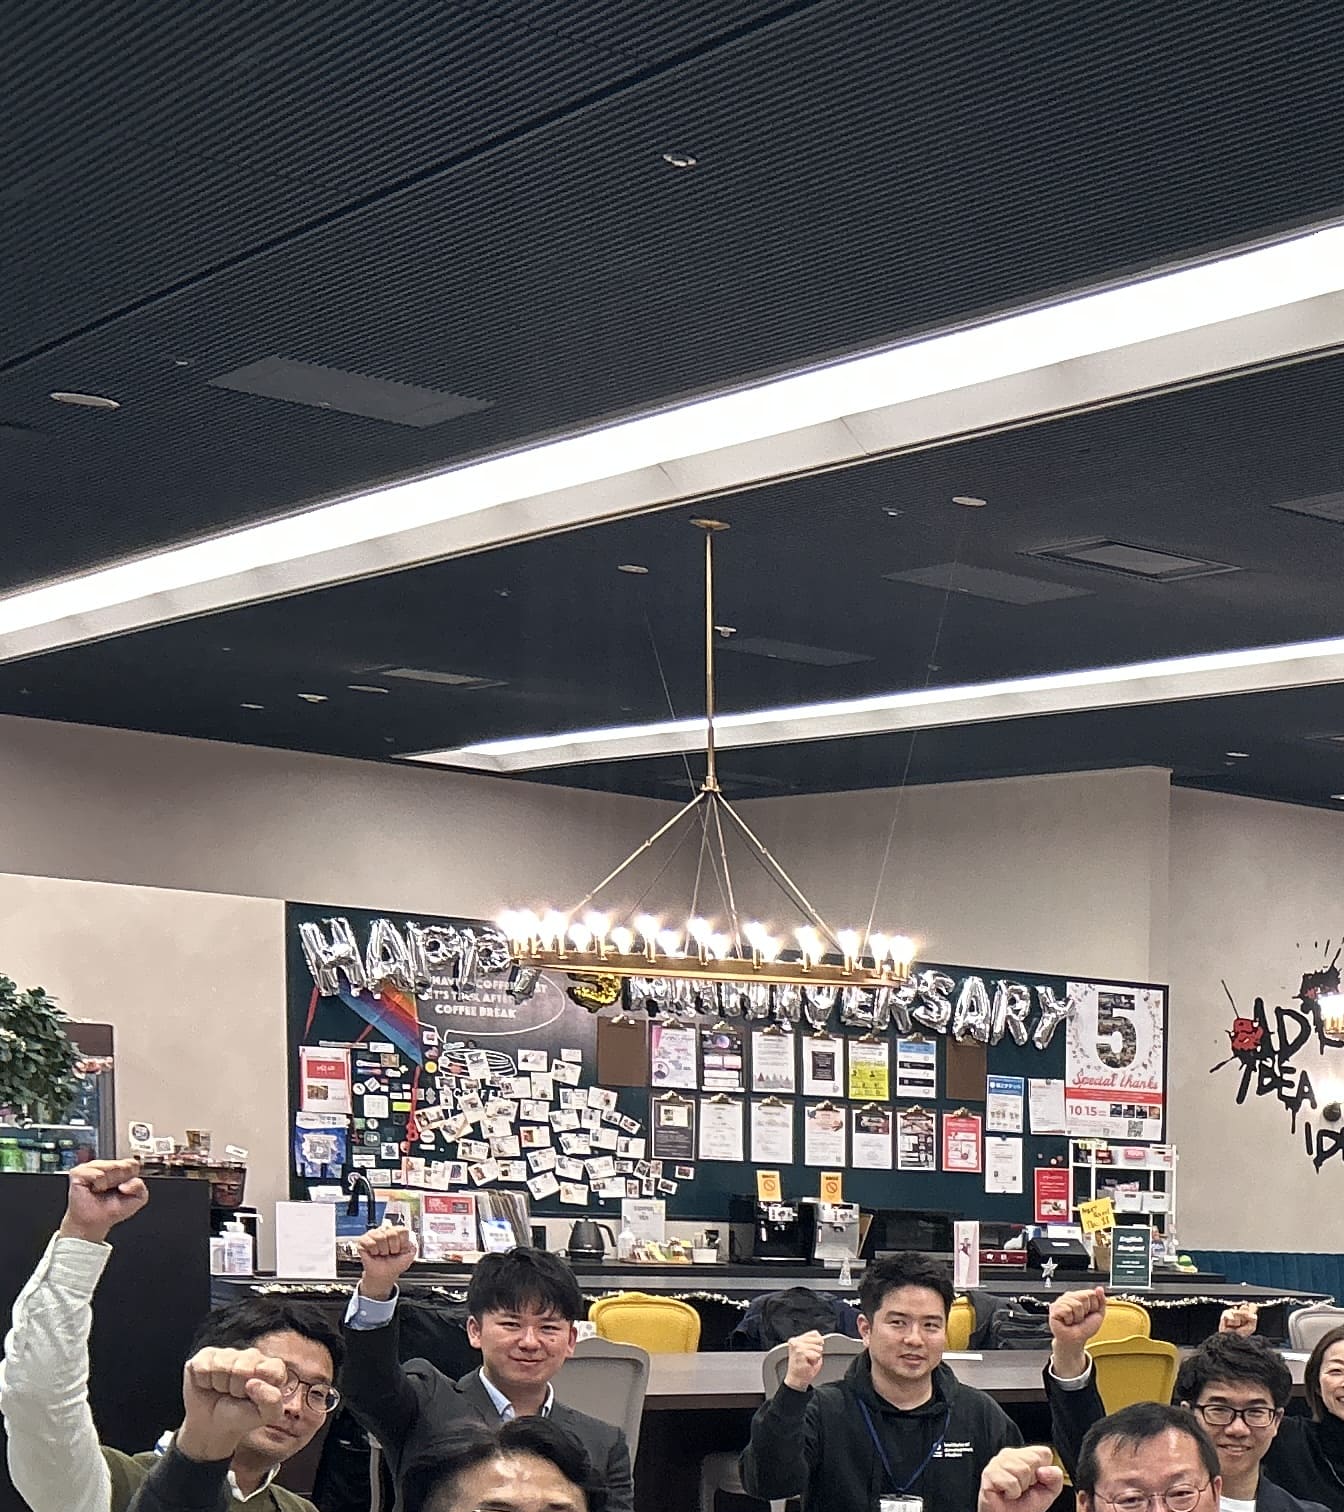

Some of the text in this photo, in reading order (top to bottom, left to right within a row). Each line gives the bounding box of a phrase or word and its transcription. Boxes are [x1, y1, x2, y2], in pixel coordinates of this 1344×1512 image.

[434, 1004, 517, 1019] COFFEE BREAK
[1096, 992, 1137, 1068] 5
[1071, 1069, 1115, 1088] Special
